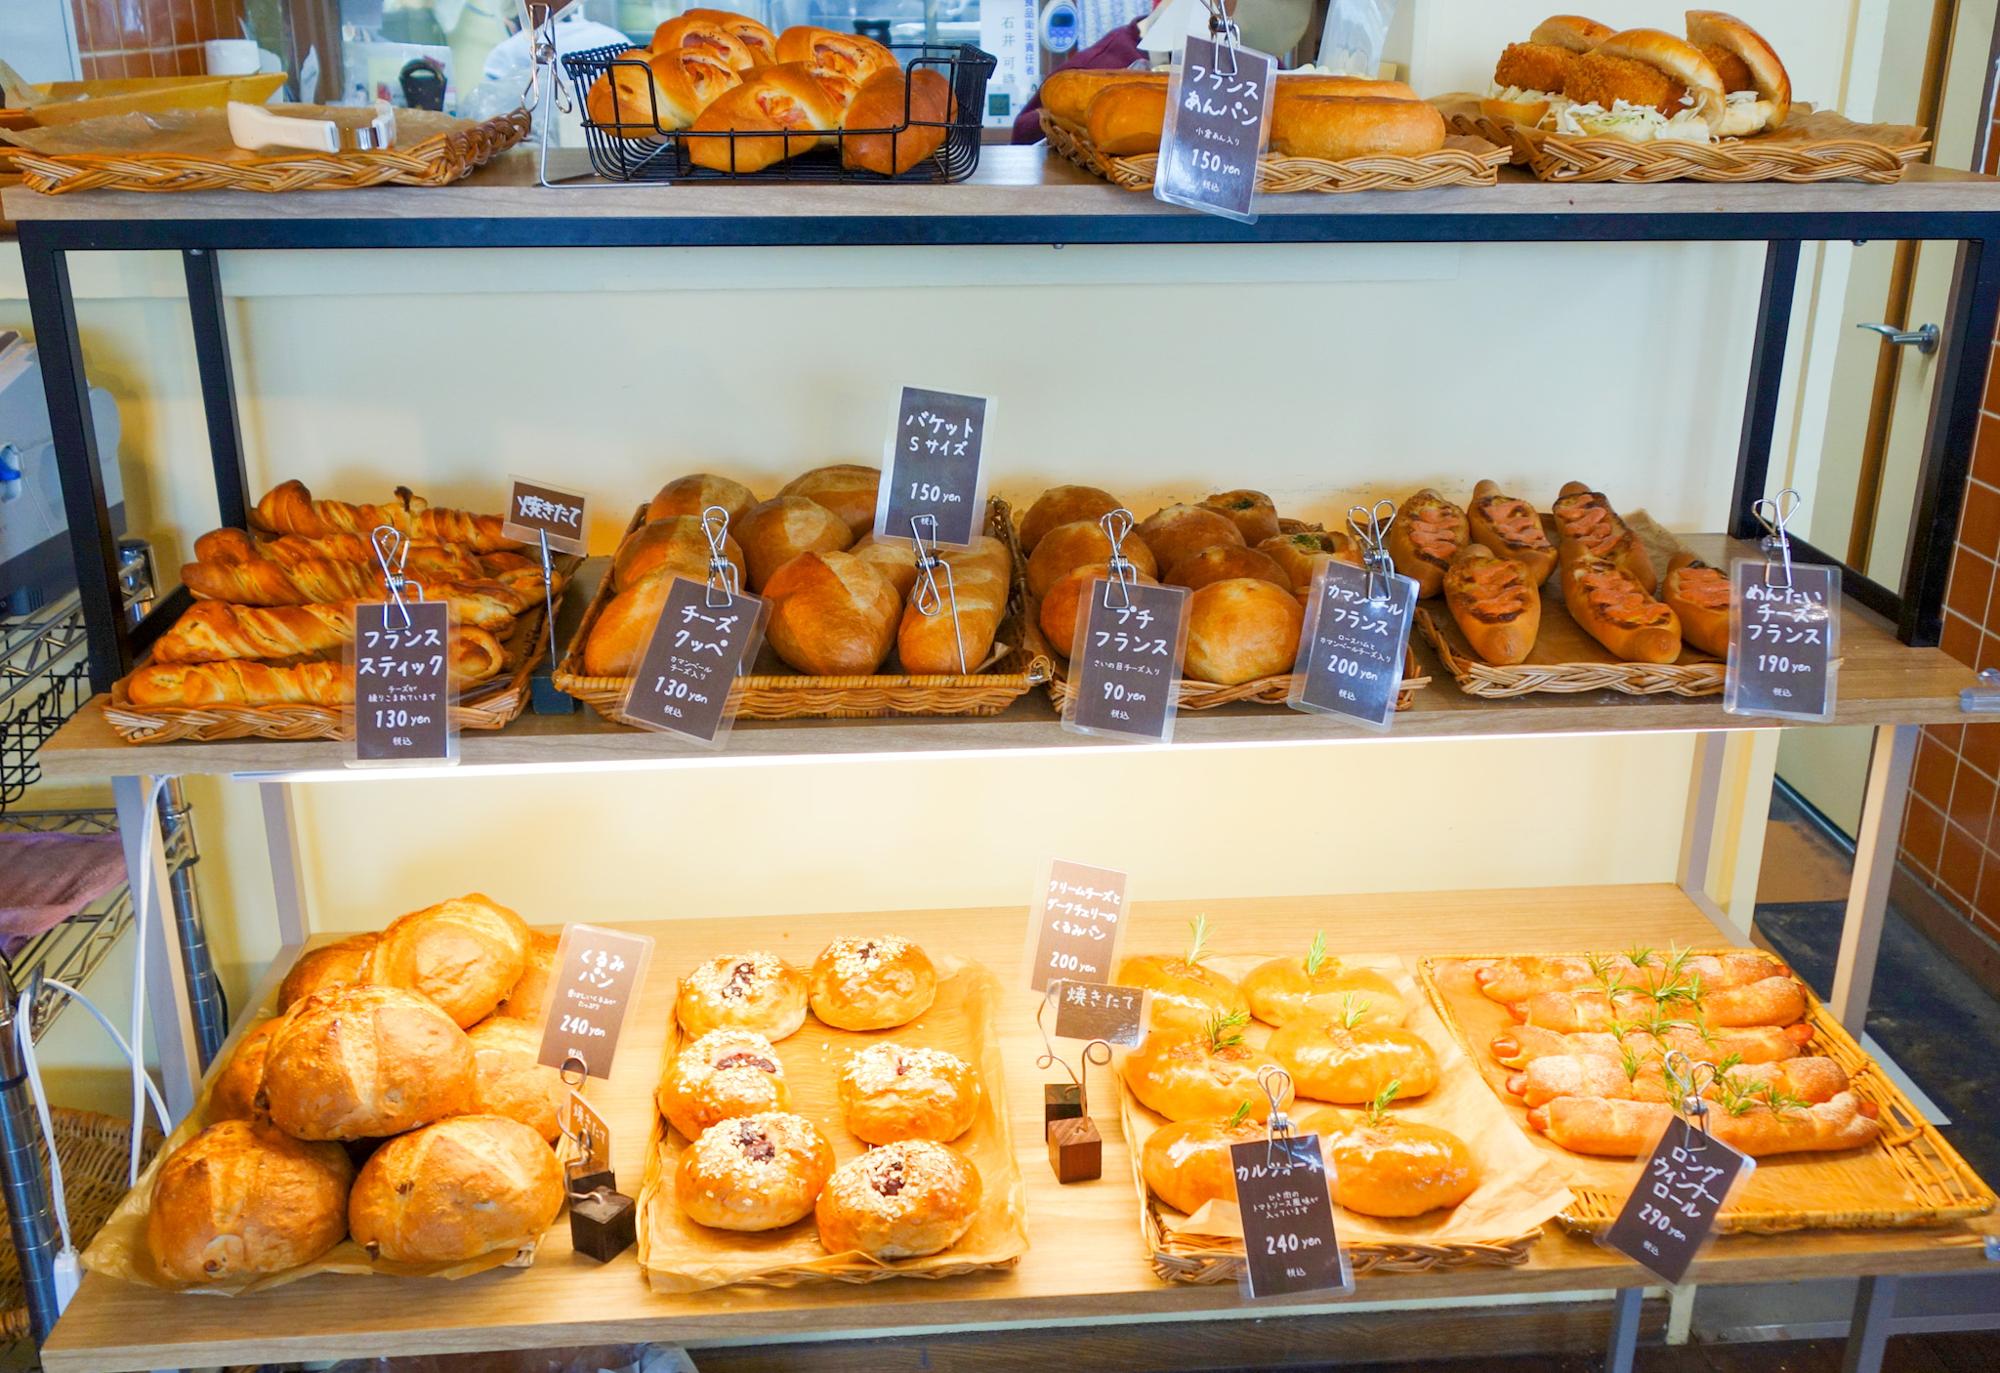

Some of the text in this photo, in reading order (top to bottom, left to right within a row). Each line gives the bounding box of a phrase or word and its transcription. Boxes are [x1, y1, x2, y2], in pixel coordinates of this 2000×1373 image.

[1191, 65, 1259, 100] フランス
[1184, 90, 1258, 125] あんパン
[1195, 127, 1240, 146] 小倉あん入り
[1191, 149, 1241, 176] 150 yen
[906, 410, 973, 439] バケット
[909, 436, 968, 456] S サイズ
[911, 482, 961, 503] 150 yen
[517, 495, 582, 528] 焼きたて
[1745, 584, 1822, 605] めんたい
[681, 605, 739, 634] チーズ
[1116, 605, 1154, 629] プチ
[1334, 608, 1388, 636] フランス
[1757, 602, 1811, 623] チーズ
[364, 629, 441, 649] フランス
[674, 629, 729, 656] クッペ
[1095, 632, 1168, 656] フランス
[1338, 634, 1375, 650] ロースハムと
[1747, 624, 1821, 644] フランス
[1320, 637, 1391, 663] カマンベールチーズ入り
[359, 655, 443, 678] スティック
[670, 655, 712, 674] カマンベール
[670, 664, 706, 681] チーズ入り
[1094, 660, 1160, 676] さいの目チーズ入り
[1328, 654, 1378, 681] 200 yen
[1758, 655, 1811, 674] 190 yen
[388, 685, 418, 694] チーズが
[654, 676, 708, 704] 130 yen
[1104, 682, 1146, 702] 90 yen
[375, 709, 431, 728] 130 yen
[1049, 880, 1121, 905] クリームチーズと
[1047, 898, 1118, 923] ダークチェリーの
[1051, 920, 1106, 941] くるみパン
[581, 949, 625, 972] くるみ
[1050, 951, 1097, 973] 200 yen
[578, 967, 614, 988] パン
[1067, 985, 1134, 1011] 焼きたて
[560, 1014, 606, 1037] 240 yen
[1671, 1146, 1725, 1183] ロング
[1653, 1156, 1720, 1204] ウィンナー
[1268, 1190, 1299, 1202] ひき肉の
[1653, 1182, 1702, 1218] ロール
[1265, 1207, 1308, 1219] 入っています
[1638, 1203, 1687, 1242] 290 yen
[1265, 1233, 1322, 1255] 240 yen
